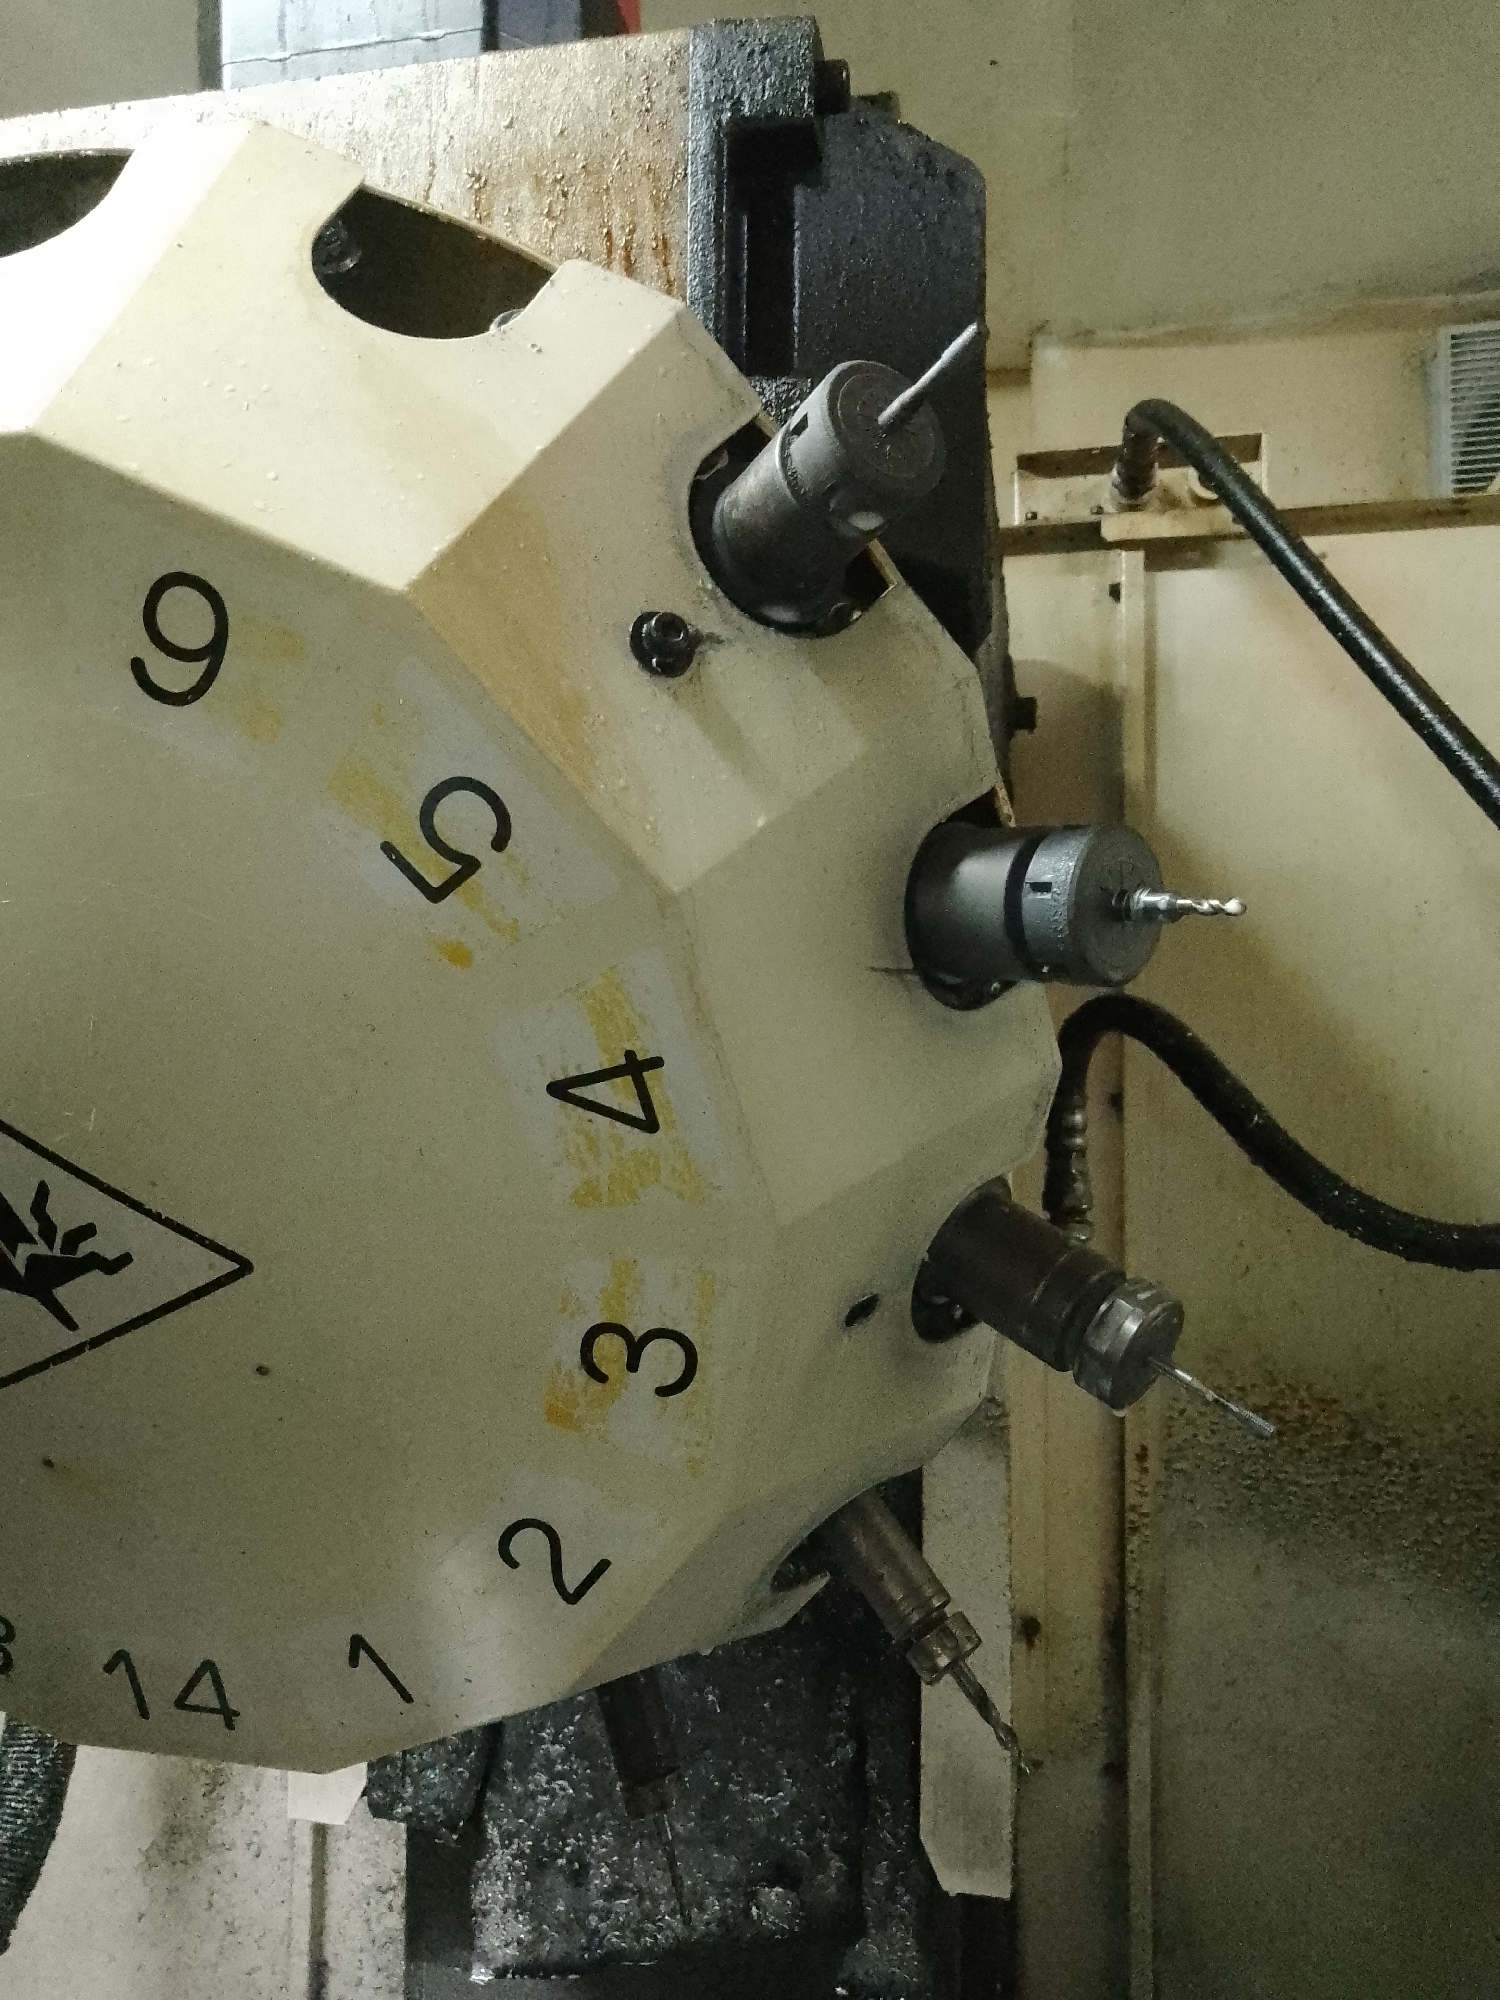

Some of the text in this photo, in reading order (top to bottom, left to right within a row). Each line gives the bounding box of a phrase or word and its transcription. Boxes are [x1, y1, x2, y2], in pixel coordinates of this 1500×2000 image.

[380, 776, 511, 904] 5
[546, 1050, 664, 1134] 4
[580, 1322, 698, 1397] 3
[498, 1518, 612, 1605] 2
[102, 1649, 240, 1731] 14
[348, 1634, 414, 1704] 1
